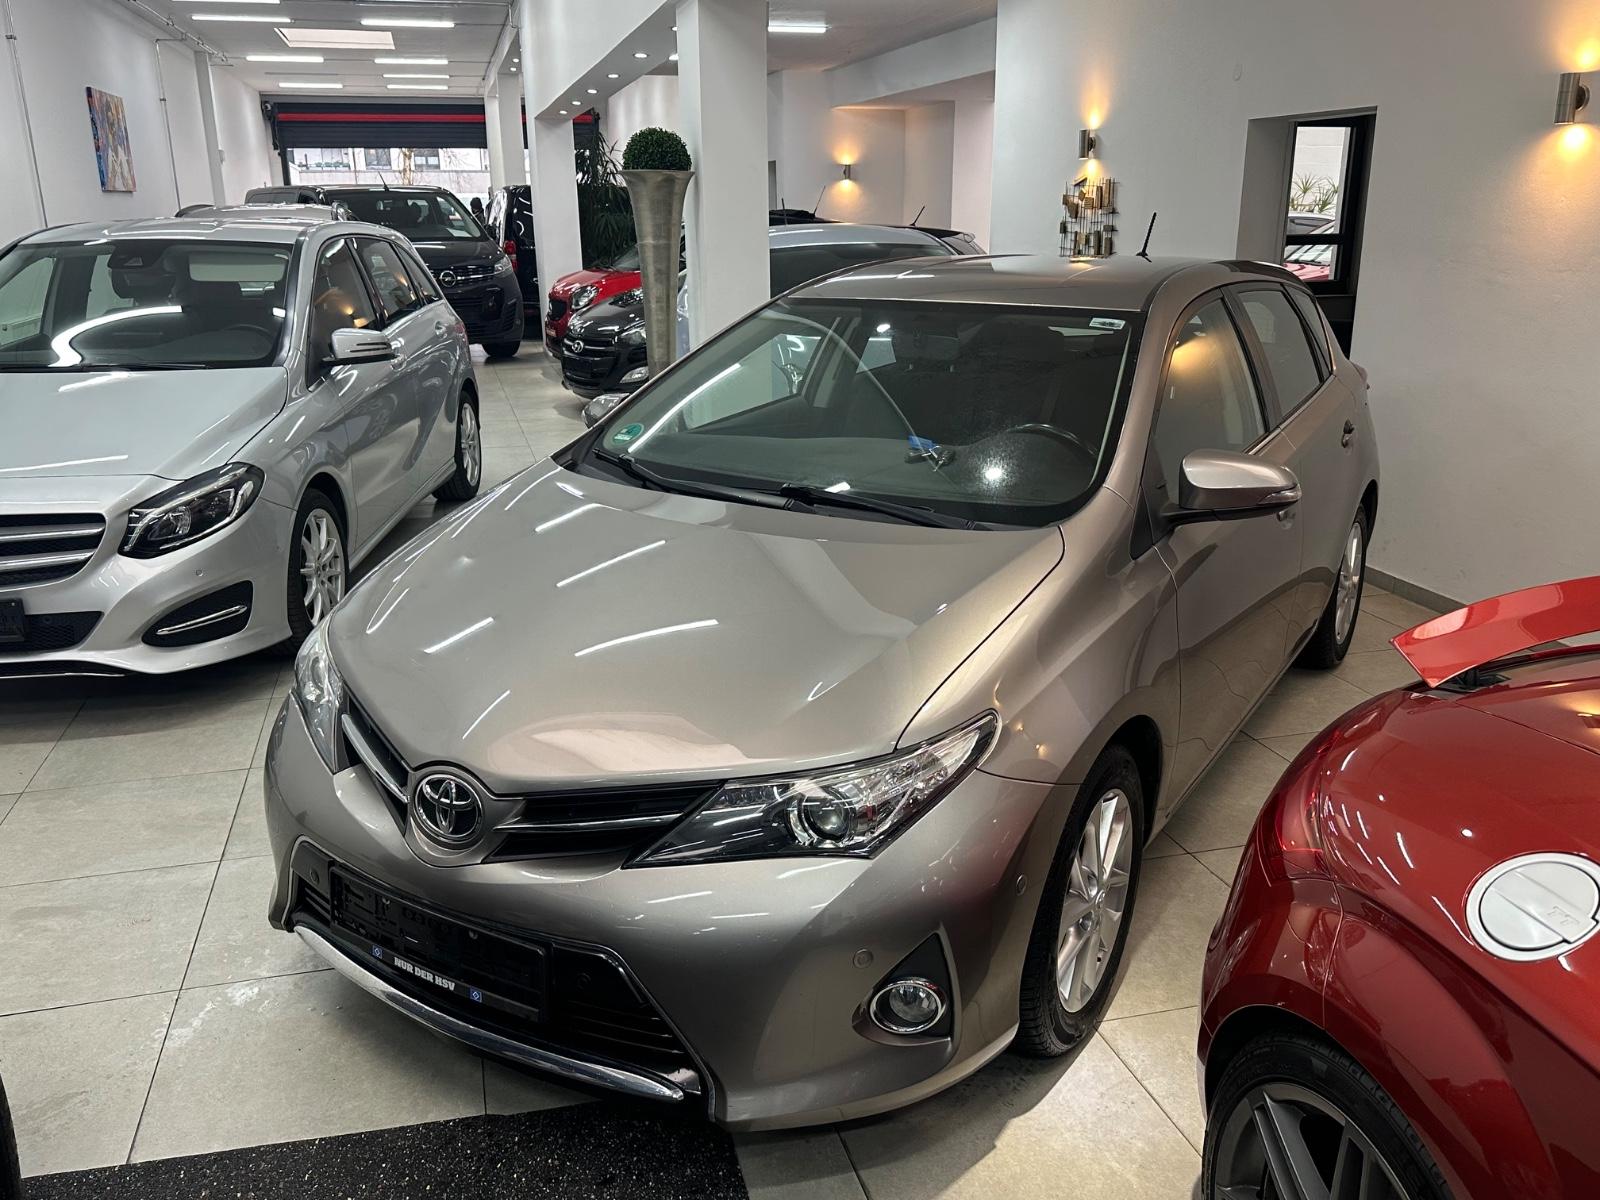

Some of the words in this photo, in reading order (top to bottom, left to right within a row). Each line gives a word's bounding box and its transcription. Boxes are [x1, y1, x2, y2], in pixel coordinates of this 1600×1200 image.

[394, 957, 413, 973] NUR
[415, 966, 433, 983] DER
[435, 975, 455, 991] HSV
